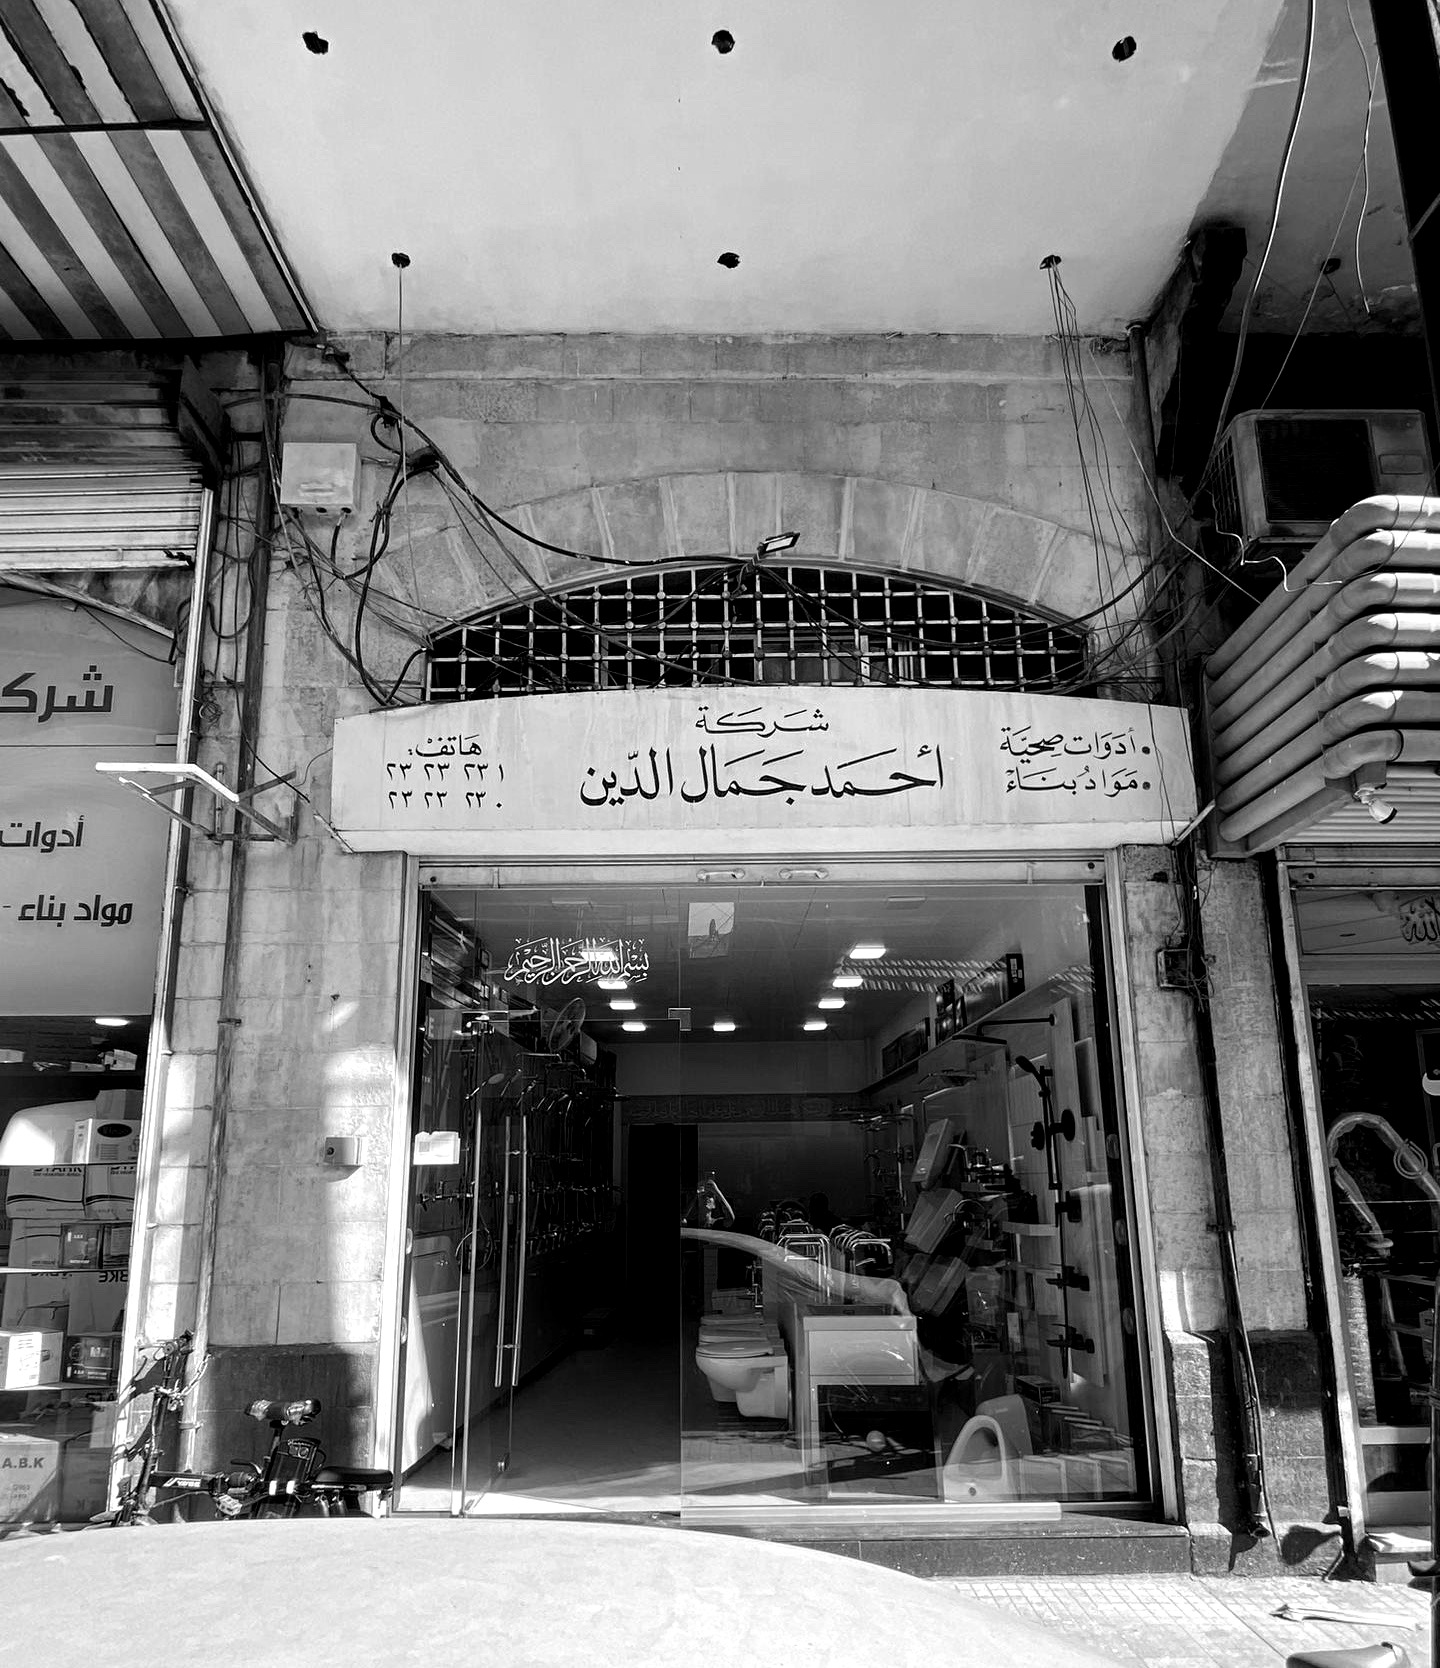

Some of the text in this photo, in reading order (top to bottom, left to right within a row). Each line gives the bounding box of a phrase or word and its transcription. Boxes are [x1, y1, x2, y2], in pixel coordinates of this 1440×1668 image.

[0, 664, 114, 723] شرك
[0, 814, 85, 854] أدوات
[17, 893, 67, 929] بناء
[73, 893, 134, 928] مواد
[1, 1457, 46, 1470] A.B.K
